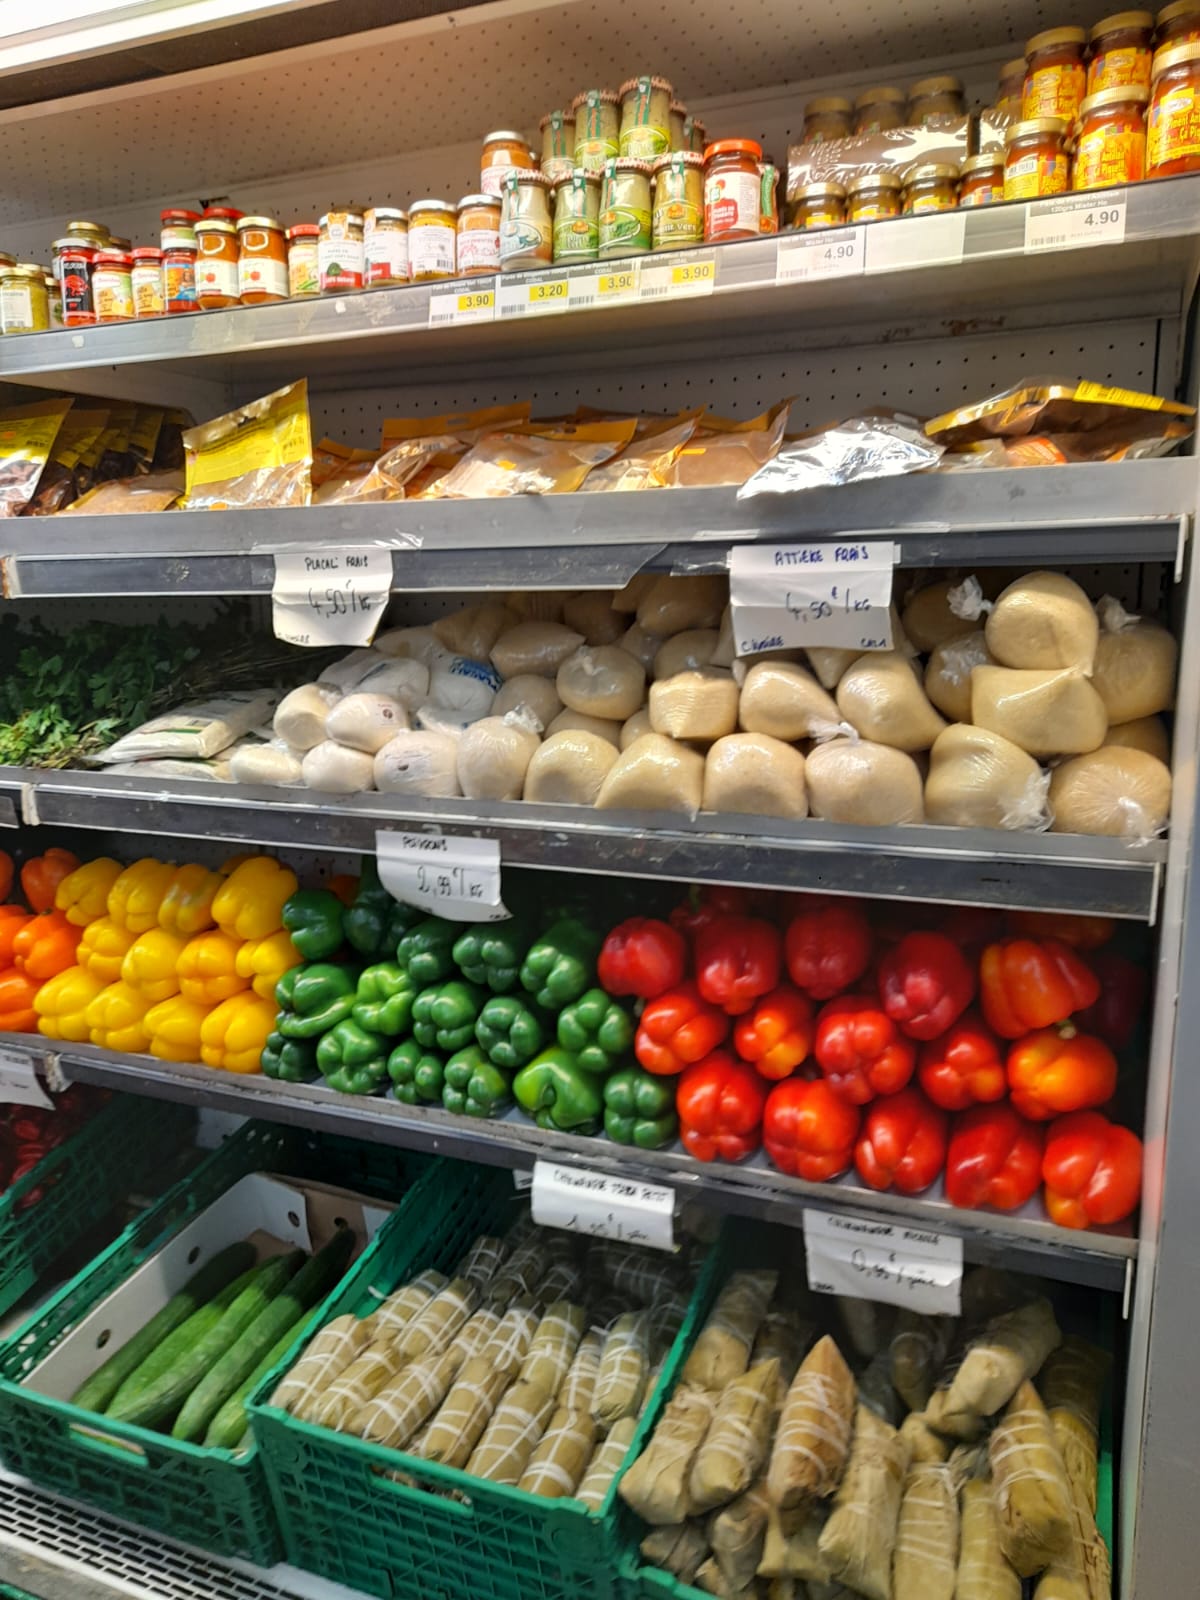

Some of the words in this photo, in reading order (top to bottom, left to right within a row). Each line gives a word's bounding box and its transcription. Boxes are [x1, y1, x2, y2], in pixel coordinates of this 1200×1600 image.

[1084, 209, 1119, 226] 4.90
[824, 244, 854, 260] 4.90
[682, 266, 709, 280] 3.90
[538, 284, 562, 298] 3.20
[466, 294, 489, 308] 3.90
